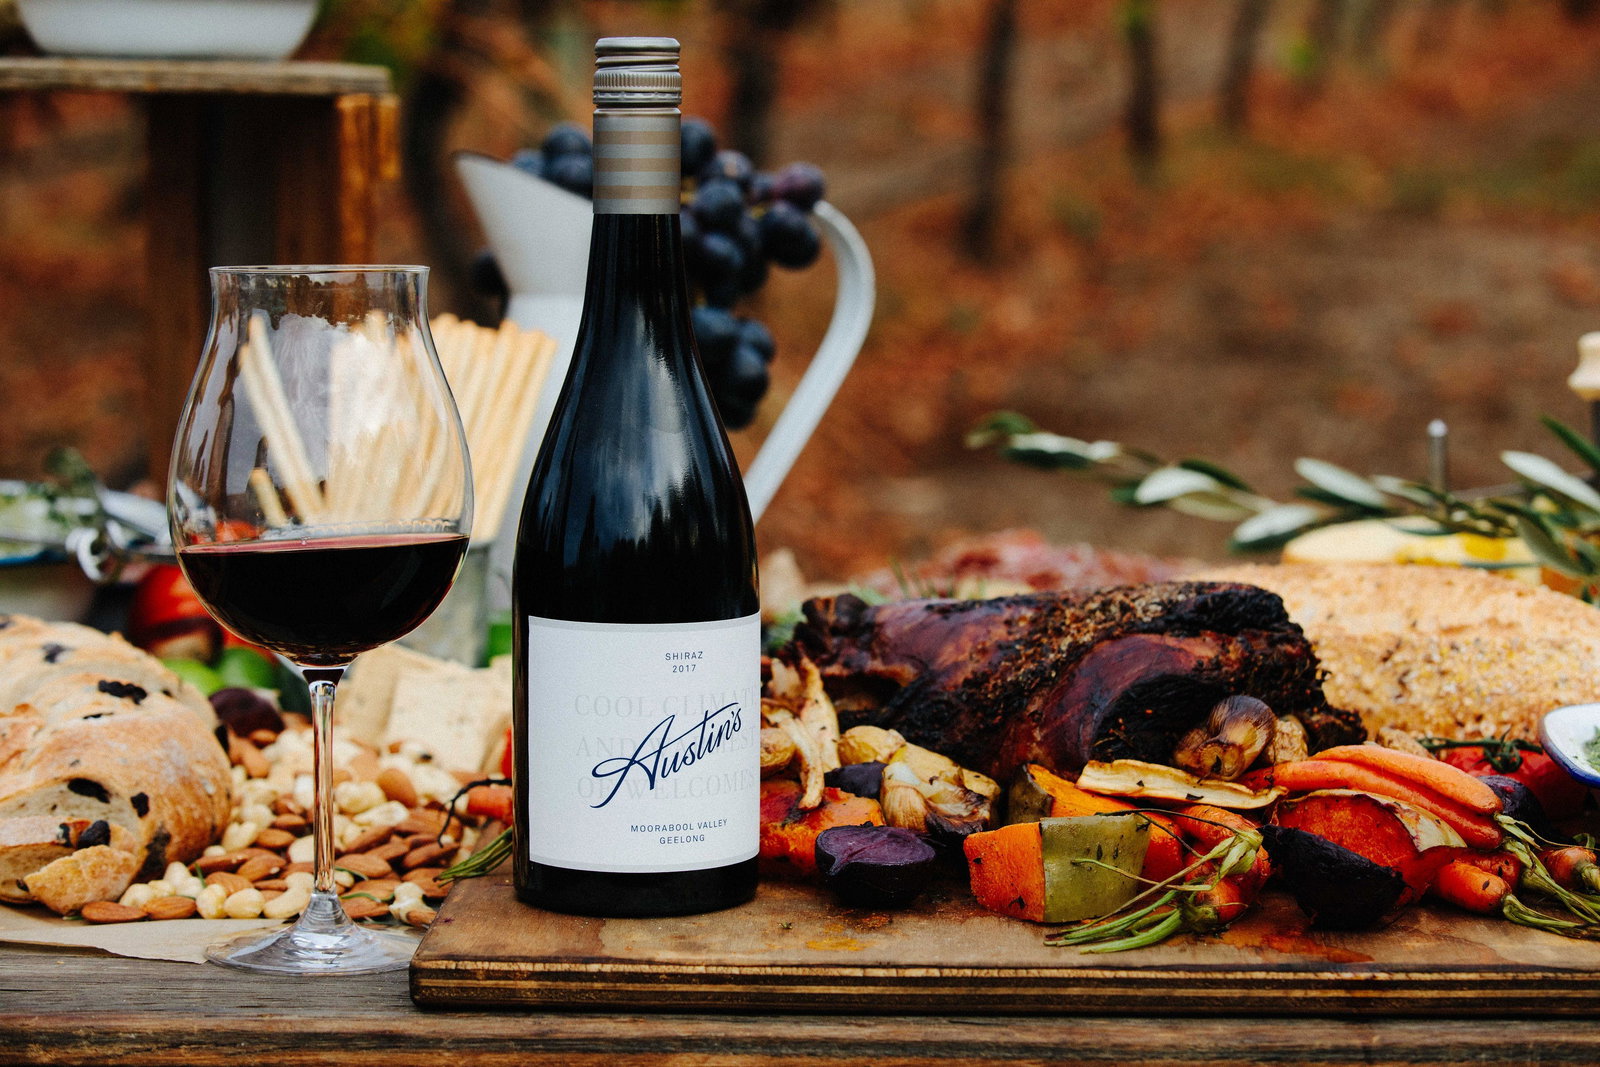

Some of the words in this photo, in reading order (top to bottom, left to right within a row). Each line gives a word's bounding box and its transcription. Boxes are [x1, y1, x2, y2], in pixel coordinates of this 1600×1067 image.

[665, 651, 704, 661] SHIRAZ
[672, 664, 697, 673] 2017
[574, 694, 655, 718] COOL
[575, 735, 636, 758] AND
[590, 702, 742, 809] Austin's
[630, 823, 694, 833] MOORABOOL
[697, 818, 728, 830] VALLEY
[659, 834, 705, 845] GEELONG
